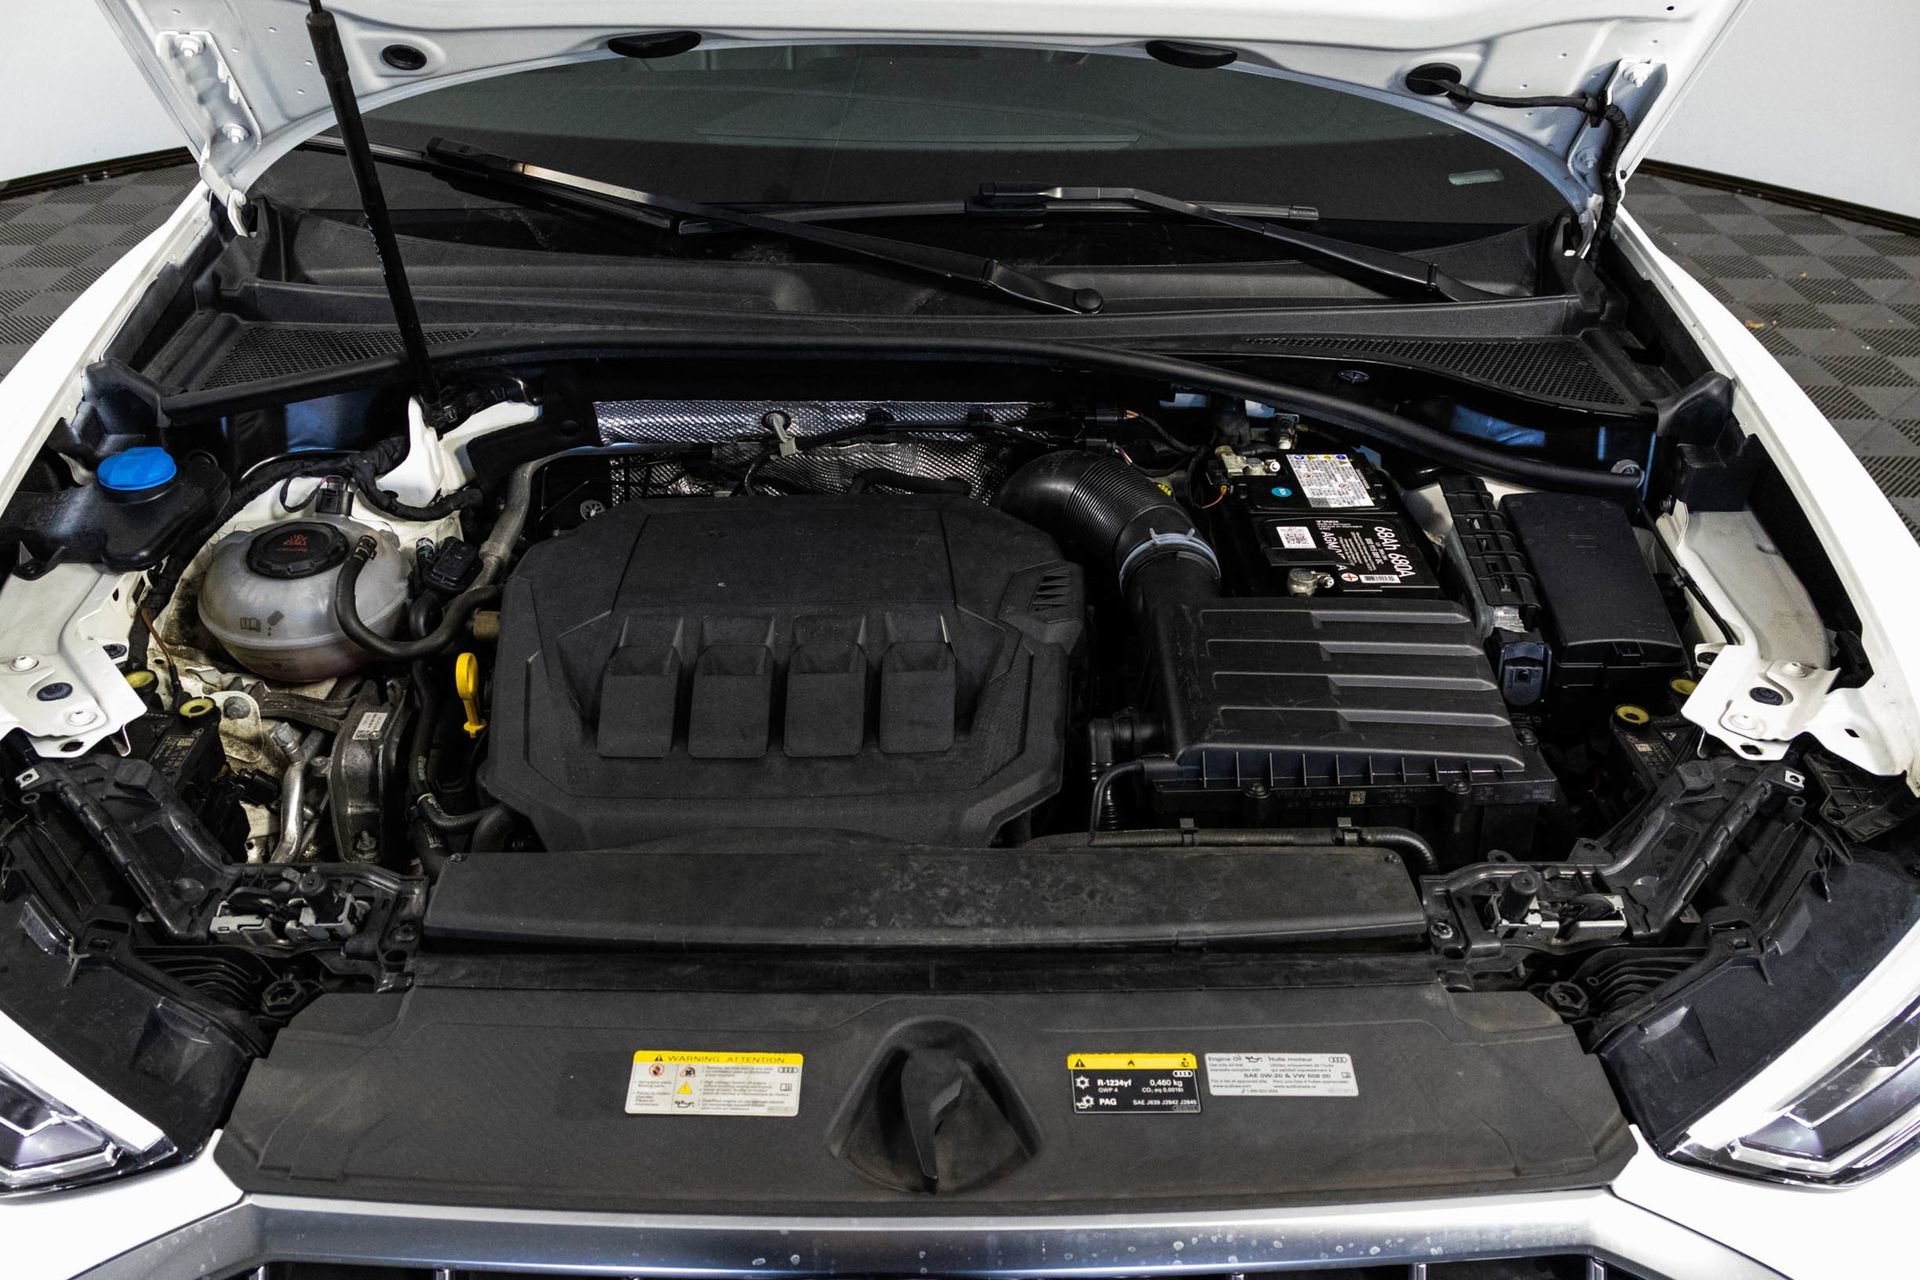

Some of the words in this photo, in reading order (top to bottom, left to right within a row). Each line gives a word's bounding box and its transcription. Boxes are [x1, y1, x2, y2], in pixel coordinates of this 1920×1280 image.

[1374, 526, 1401, 550] 68Ah
[1388, 553, 1416, 577] 680A
[668, 1055, 720, 1063] WARNING
[727, 1056, 785, 1064] ATTENTION
[1097, 1079, 1132, 1088] R-1234yf
[1173, 1079, 1183, 1087] kg
